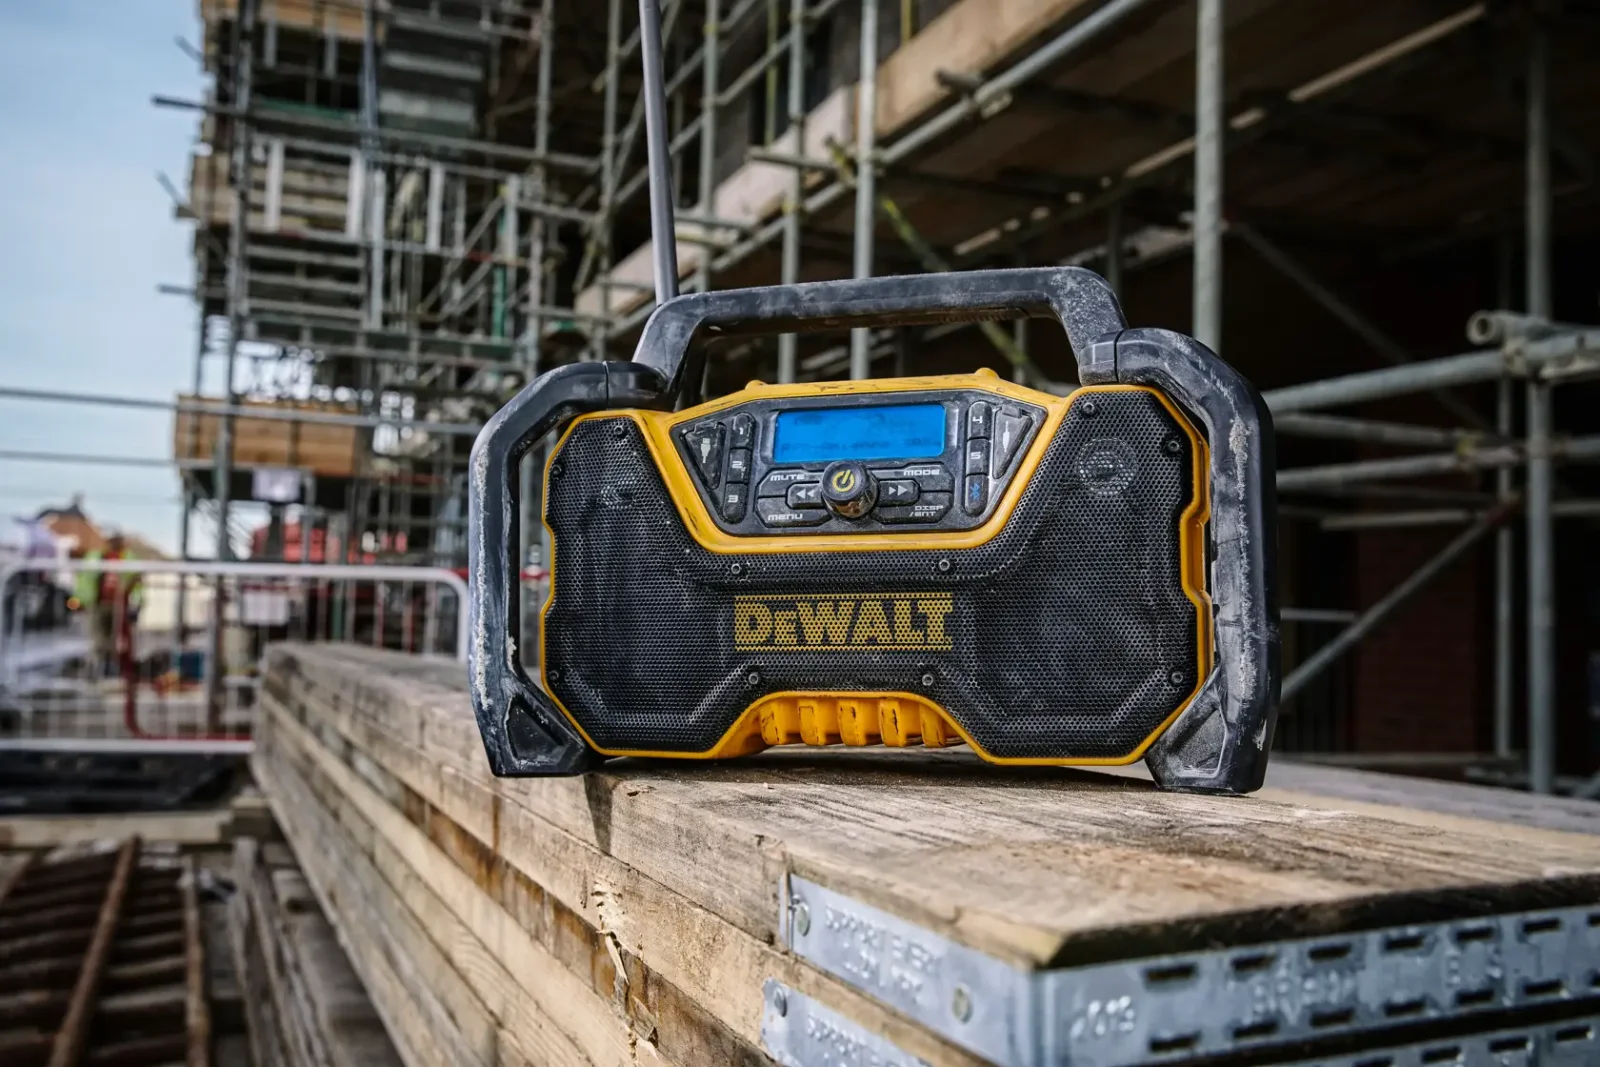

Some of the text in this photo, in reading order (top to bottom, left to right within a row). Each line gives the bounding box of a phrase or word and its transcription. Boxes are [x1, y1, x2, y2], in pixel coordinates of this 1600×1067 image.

[972, 415, 983, 424] 4
[970, 451, 981, 460] 5
[731, 460, 743, 469] 2
[903, 468, 941, 477] MODE
[770, 473, 806, 482] MUTE
[727, 494, 739, 503] 3
[767, 513, 804, 521] MENU
[734, 598, 953, 645] DEWALT
